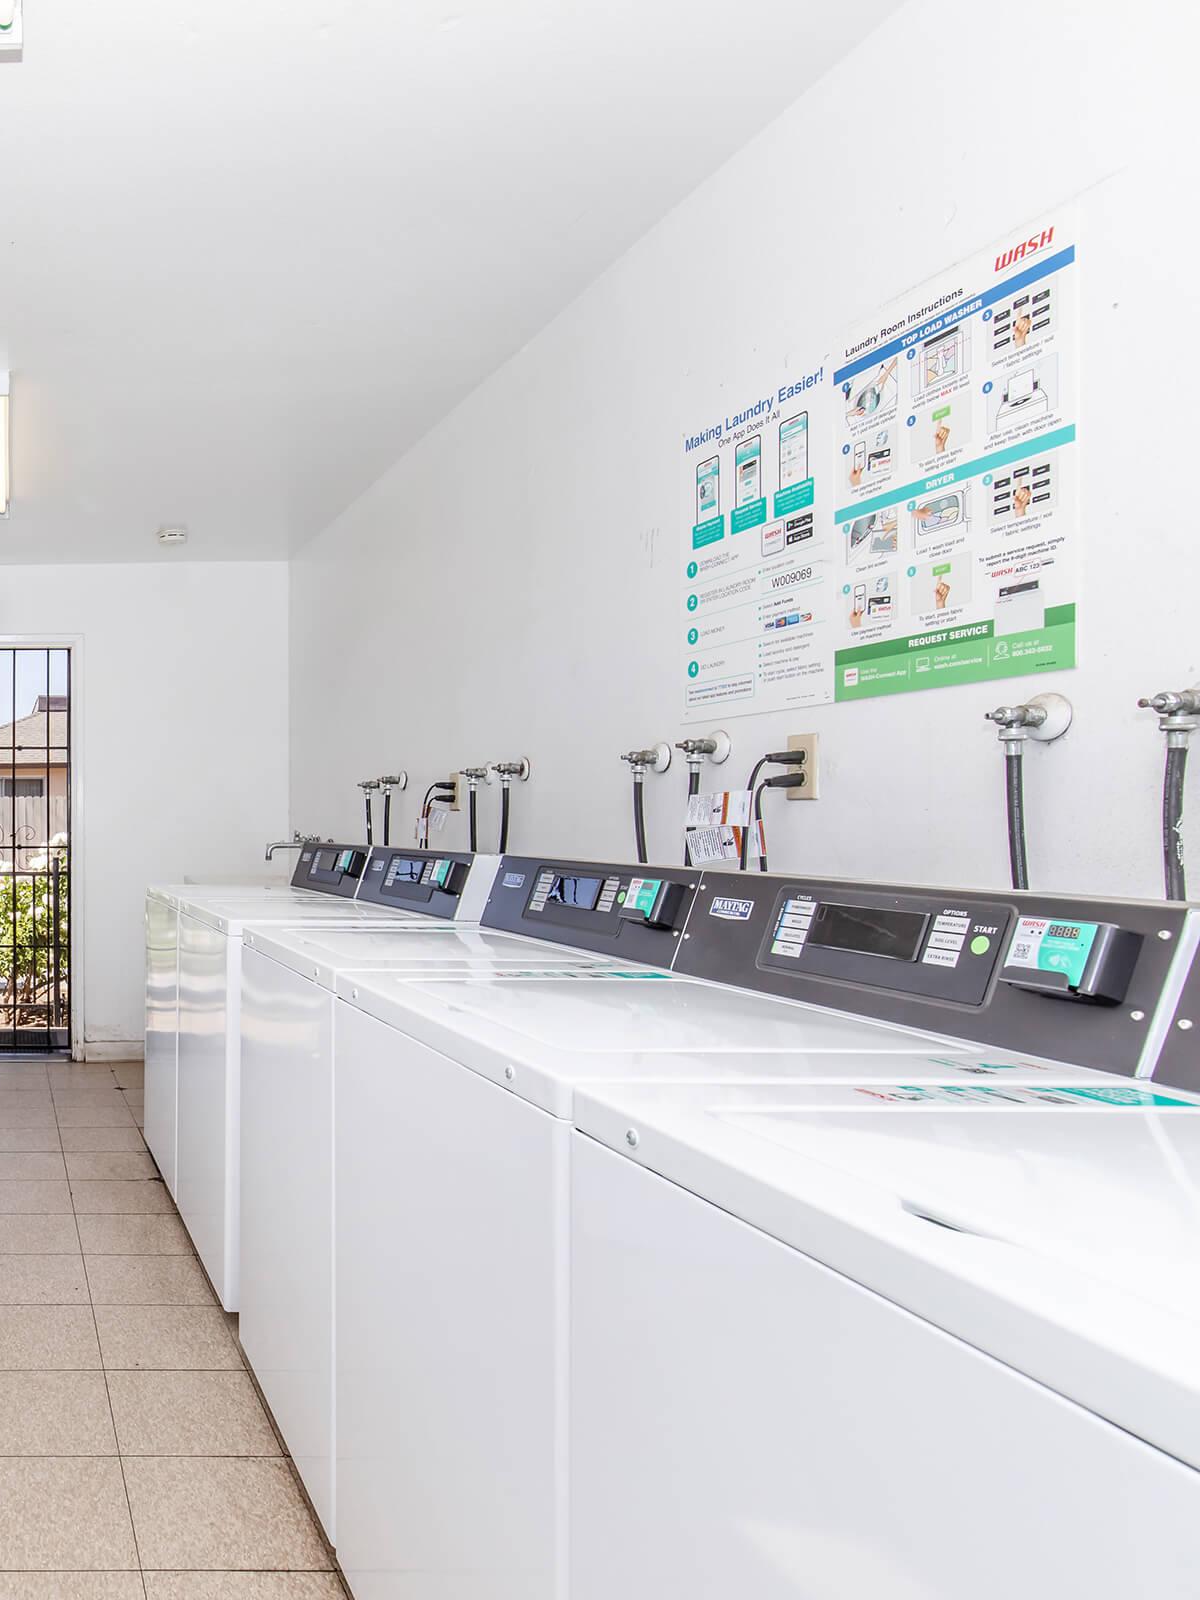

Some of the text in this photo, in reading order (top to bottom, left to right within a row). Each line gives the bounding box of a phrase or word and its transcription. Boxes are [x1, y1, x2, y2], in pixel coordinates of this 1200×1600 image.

[994, 227, 1054, 272] WASH
[845, 287, 964, 358] Laundry Room Instructions
[901, 299, 983, 347] TOP LOAD WASHER
[991, 356, 1006, 366] Select
[1008, 342, 1037, 360] temperature
[686, 367, 824, 452] Making Laundry Easier!
[1030, 413, 1053, 425] machine
[718, 436, 731, 448] One
[732, 429, 745, 441] App
[746, 422, 764, 434] Does
[771, 410, 781, 420] All
[926, 473, 954, 490] DRYER
[1007, 515, 1038, 529] temperature
[1020, 522, 1040, 532] settings
[1047, 536, 1064, 544] simply
[1028, 547, 1049, 555] machine
[992, 568, 1014, 578] WASH
[1014, 564, 1028, 574] ABC
[1030, 562, 1040, 570] 123
[772, 567, 812, 588] W009069
[690, 598, 695, 607] 2
[690, 631, 696, 641] 3
[908, 624, 988, 648] REQUEST SERVICE
[690, 664, 696, 674] 4
[714, 899, 750, 913] MAYTAG
[943, 909, 968, 917] OPTIONS
[936, 920, 967, 928] TEMPERATURE
[973, 926, 998, 934] START
[1022, 920, 1047, 928] WASH
